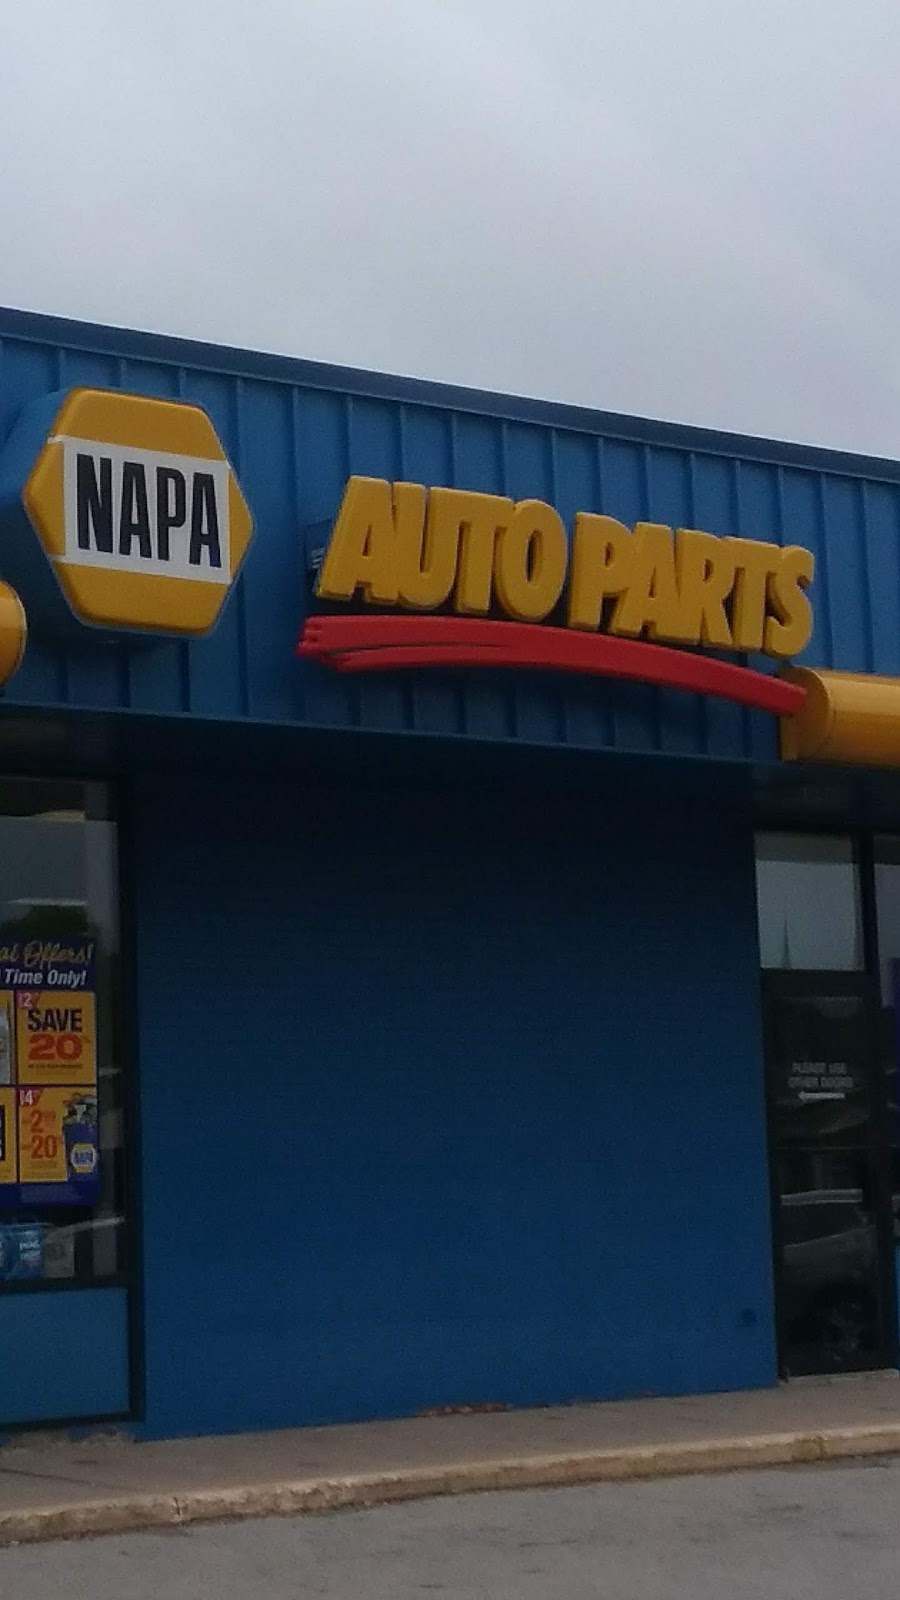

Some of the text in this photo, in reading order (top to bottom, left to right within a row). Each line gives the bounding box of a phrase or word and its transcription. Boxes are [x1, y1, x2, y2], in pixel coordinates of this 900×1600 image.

[76, 453, 222, 568] NAPA
[317, 475, 815, 656] AUTO PARTS
[5, 968, 87, 988] Time Only!
[28, 1008, 82, 1032] SAVE
[28, 1034, 82, 1060] 20
[31, 1135, 57, 1159] 20
